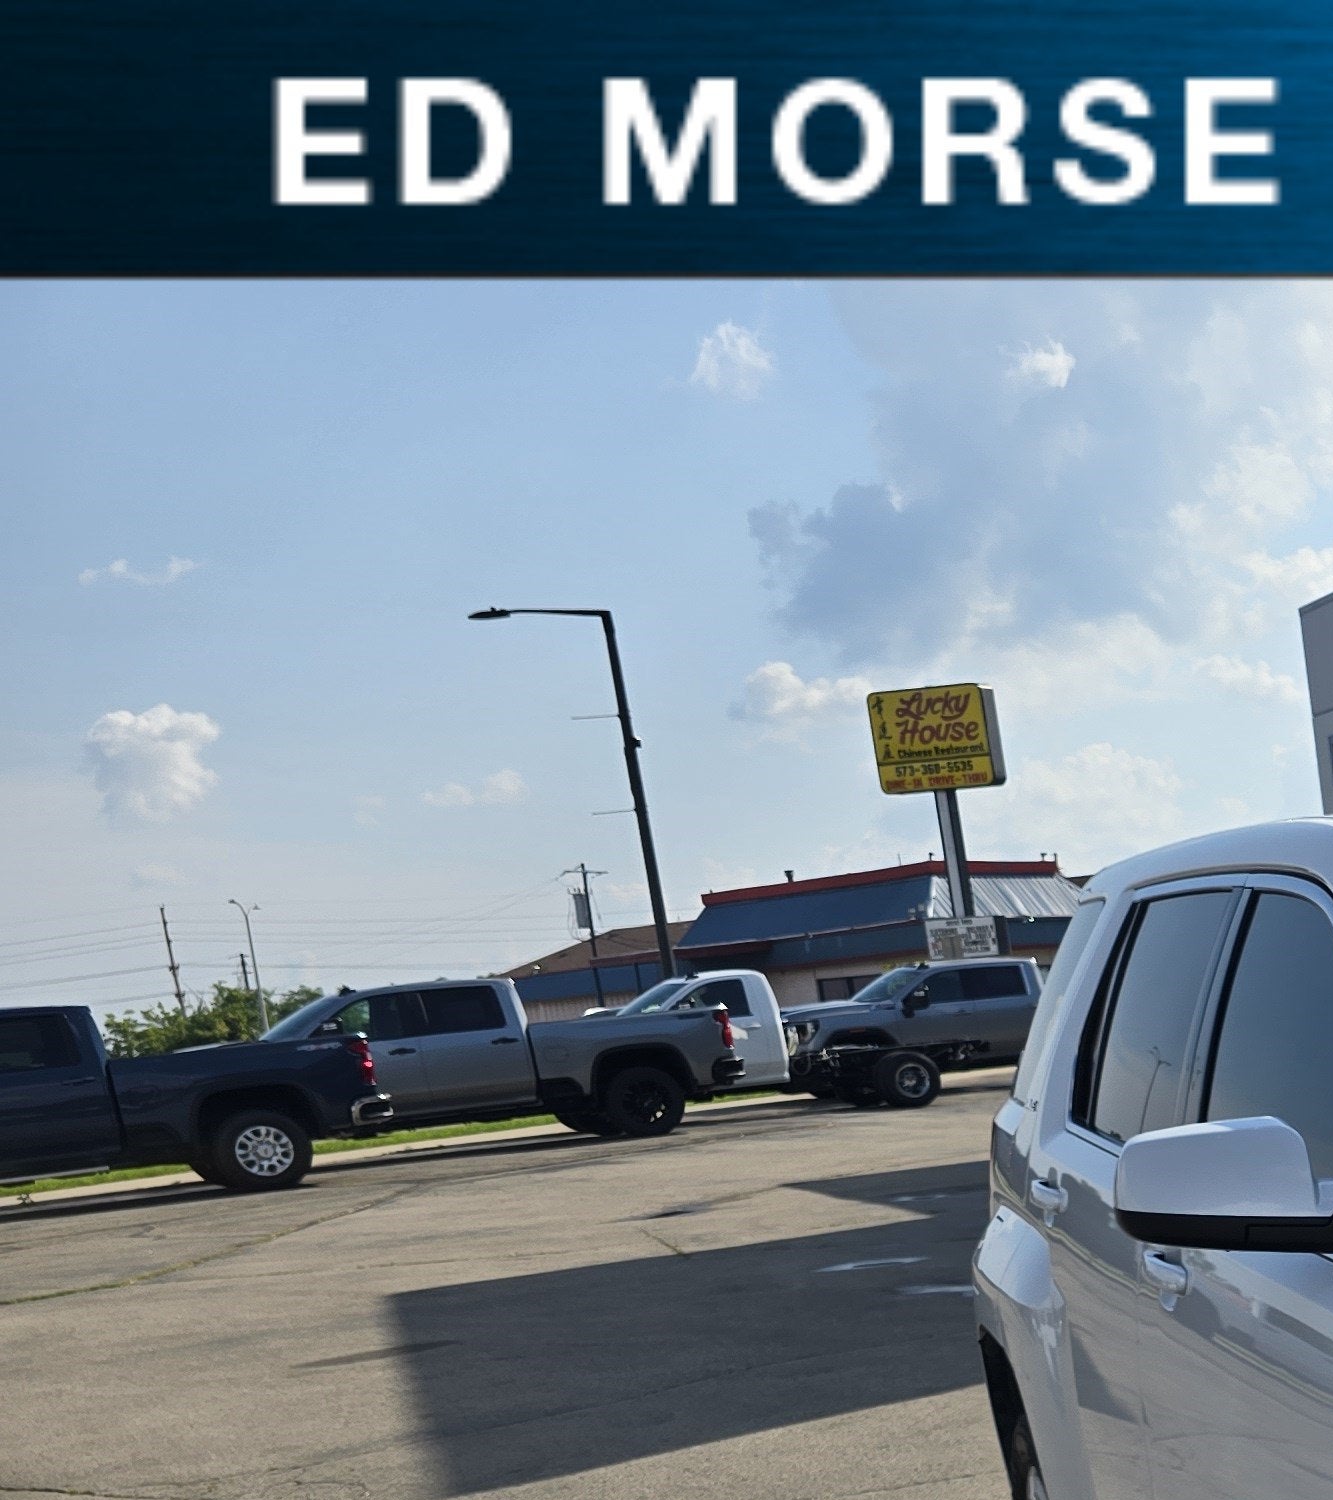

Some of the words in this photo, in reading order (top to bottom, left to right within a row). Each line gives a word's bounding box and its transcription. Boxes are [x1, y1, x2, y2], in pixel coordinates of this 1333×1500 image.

[895, 690, 971, 721] Lucky
[895, 720, 980, 746] House
[897, 748, 934, 760] Chinese
[933, 741, 985, 757] Restaurant
